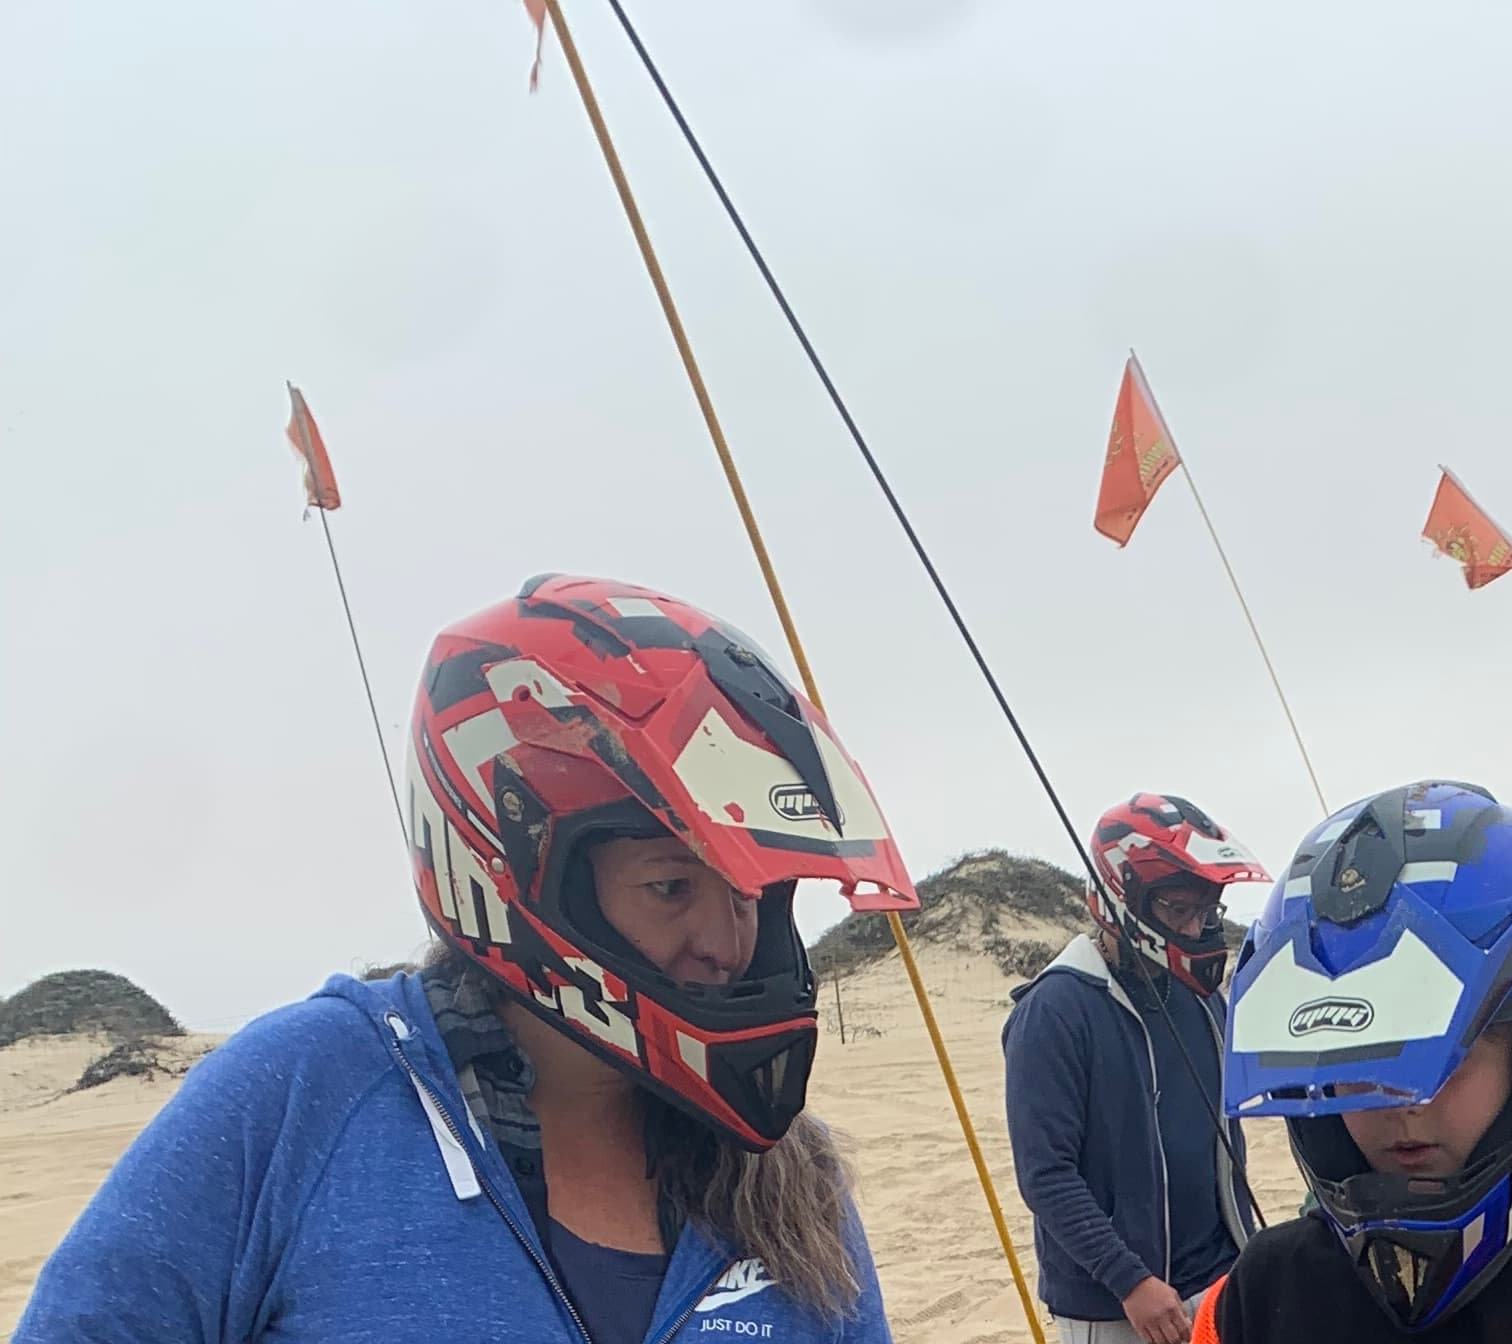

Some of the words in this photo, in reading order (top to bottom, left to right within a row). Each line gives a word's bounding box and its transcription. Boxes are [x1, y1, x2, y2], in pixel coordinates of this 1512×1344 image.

[700, 1318, 733, 1332] JUST
[735, 1321, 758, 1336] DO
[761, 1324, 774, 1338] IT
